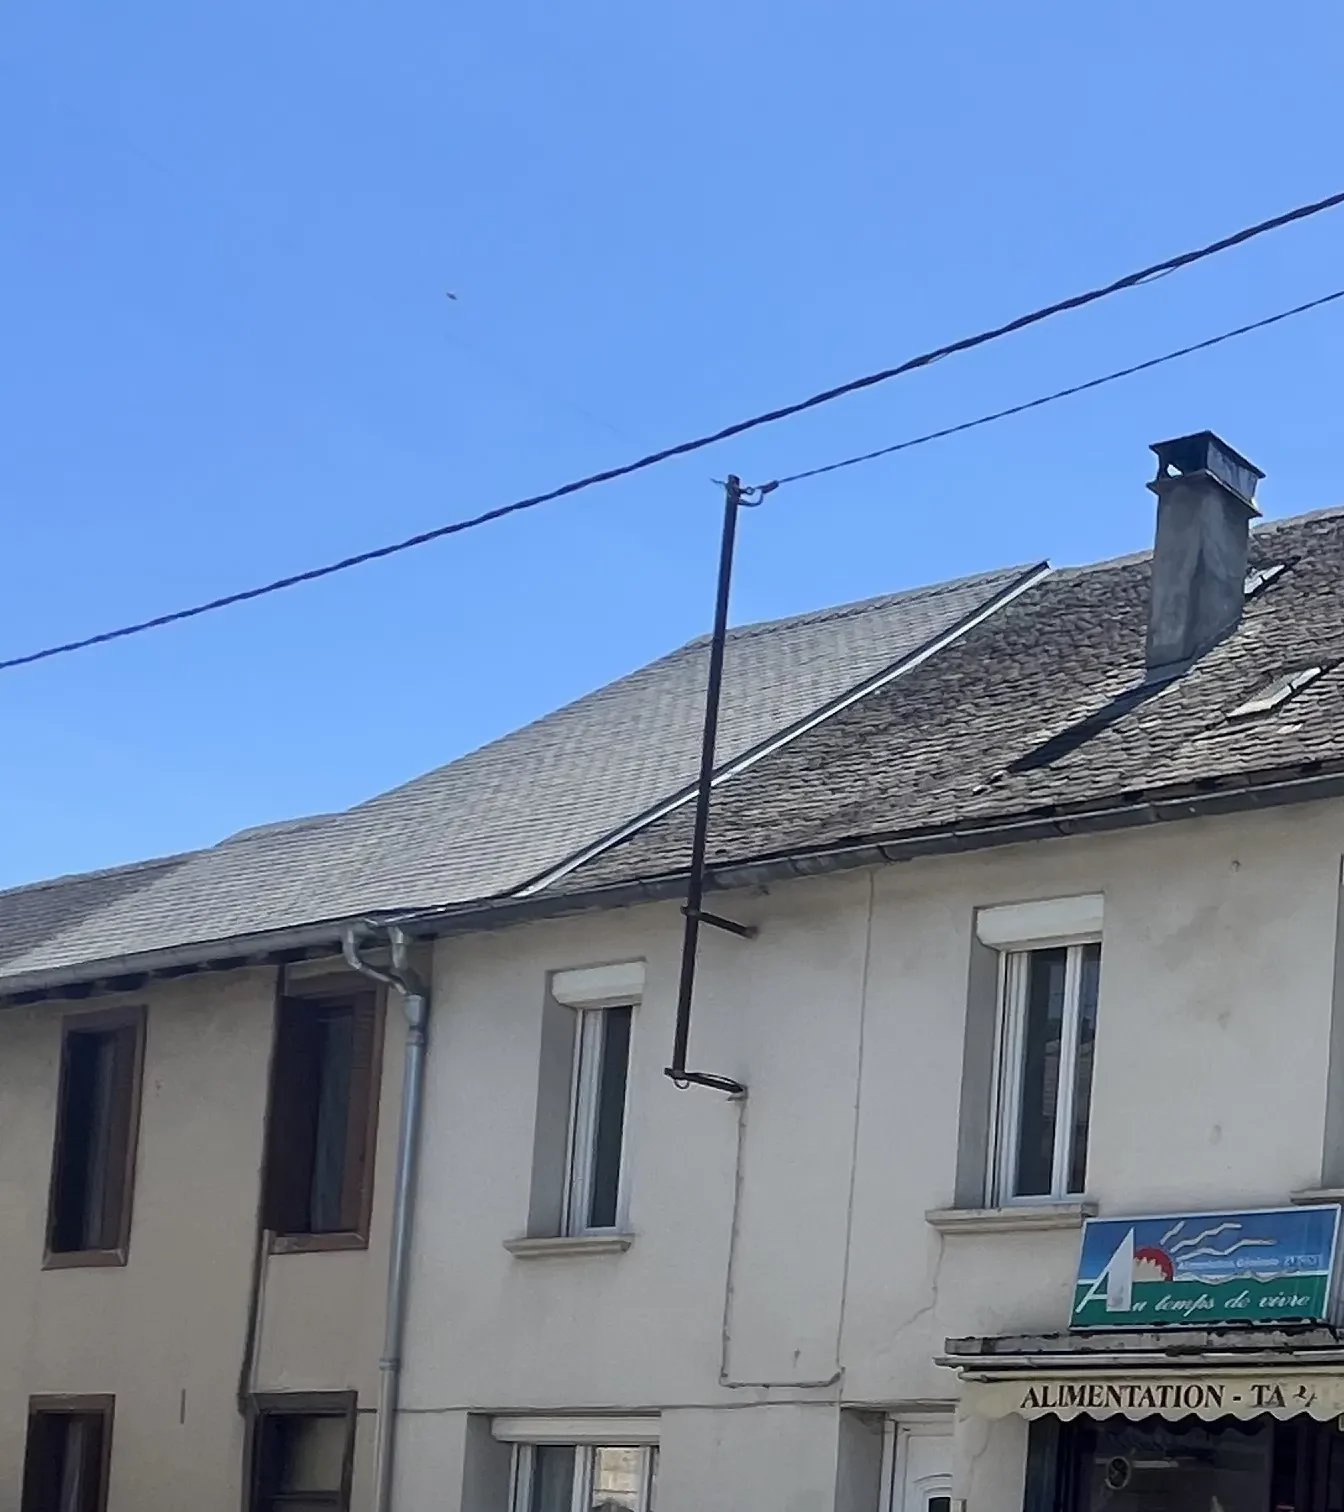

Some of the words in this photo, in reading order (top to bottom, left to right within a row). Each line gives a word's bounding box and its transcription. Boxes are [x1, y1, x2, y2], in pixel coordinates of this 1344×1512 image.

[1153, 1292, 1215, 1318] temps
[1224, 1289, 1250, 1309] de
[1258, 1290, 1311, 1309] vivre
[1020, 1384, 1225, 1409] ALIMENTATION
